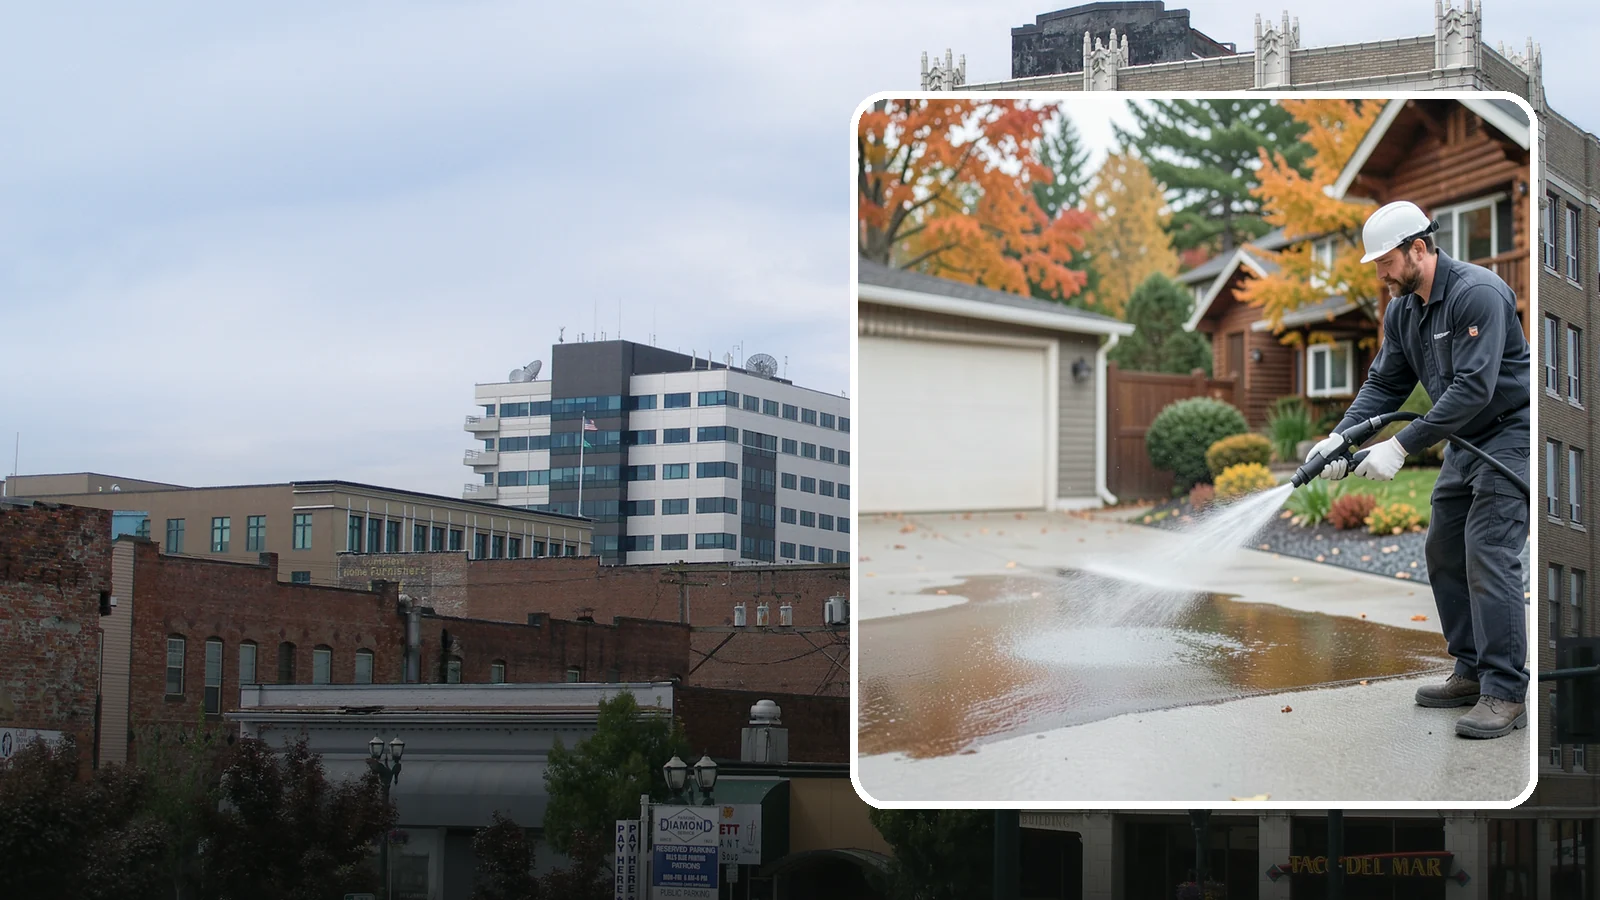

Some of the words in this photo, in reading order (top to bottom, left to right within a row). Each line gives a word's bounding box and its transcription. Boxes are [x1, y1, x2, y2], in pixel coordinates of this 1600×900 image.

[370, 566, 427, 577] Furnishers
[660, 818, 713, 833] DIAMOND
[720, 824, 740, 835] ETT
[617, 825, 625, 853] PAY
[629, 825, 637, 853] PAY
[720, 840, 740, 849] ANT
[689, 846, 716, 854] PARKING
[671, 862, 701, 870] PATRONS
[1288, 855, 1330, 874] TAC
[1346, 856, 1385, 876] DEL
[1392, 857, 1443, 877] MAR
[616, 856, 625, 894] HERE
[628, 856, 636, 894] HERE
[660, 889, 682, 897] PUBLIC
[684, 889, 710, 898] PARKING
